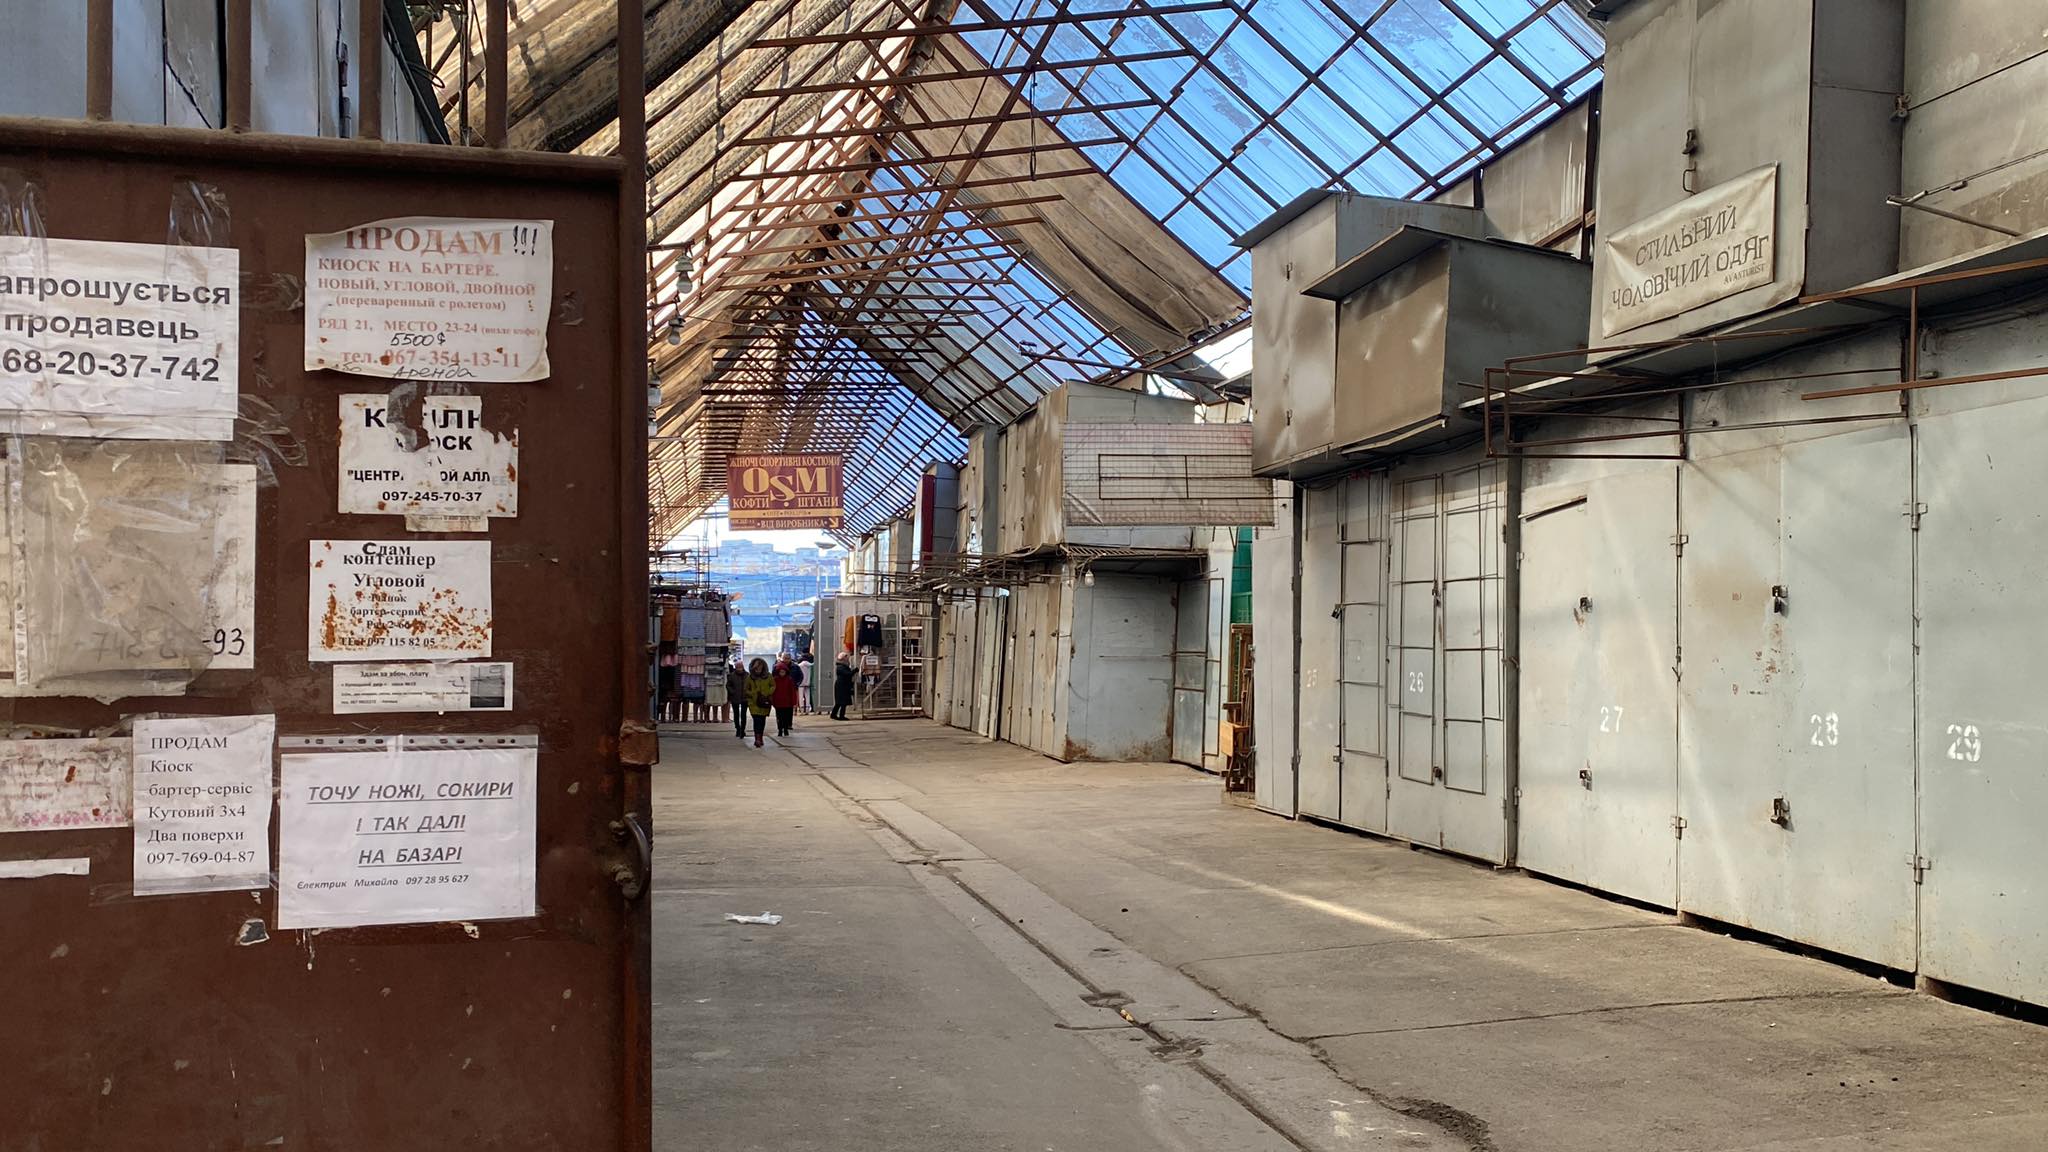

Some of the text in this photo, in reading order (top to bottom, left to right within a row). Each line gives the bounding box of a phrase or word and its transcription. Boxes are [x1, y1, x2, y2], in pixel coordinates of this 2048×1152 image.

[344, 227, 503, 256] ПРОДАМ
[1635, 203, 1737, 266] СТИЛЬНИЙ
[318, 258, 380, 272] КИОСК
[389, 261, 412, 273] НА
[0, 274, 231, 306] апрошується
[463, 283, 536, 297] ДВОЙНОЙ
[1612, 253, 1710, 310] ЧОЛОВІЧИЙ
[335, 295, 506, 312] (переваренный с ролетом)
[5, 314, 200, 343] продавець
[318, 318, 348, 330] РЯД
[384, 320, 438, 332] МЕСТО
[445, 322, 478, 333] 23-24
[2, 348, 220, 382] 68-20-37-742
[340, 351, 378, 364] тел.
[729, 455, 841, 467] ЖІНОЧІ СПОРТИВНІ КОСТЮМИ
[742, 467, 830, 502] OSM
[382, 491, 482, 501] 097-245-70-37
[733, 496, 839, 509] КОФТИ ШТАНИ
[761, 519, 776, 528] ВІД
[776, 518, 825, 528] ВИРОБНИКА
[362, 542, 411, 556] Сдам
[353, 573, 425, 587] Угловой
[389, 637, 406, 647] 115
[408, 637, 420, 647] 82
[423, 637, 436, 647] 05
[1409, 671, 1424, 693] 26
[1600, 706, 1623, 733] 27
[1810, 712, 1839, 747] 28
[151, 736, 228, 750] ПРОДАМ
[1946, 724, 1981, 762] 29
[150, 759, 193, 772] Кіоск
[149, 782, 253, 799] бартер-сервіс
[308, 781, 514, 801] ТОЧУ НОЖІ, СОКИРИ
[149, 805, 215, 822] Кутовий
[356, 814, 466, 833] І ТАК ДАЛІ
[147, 829, 244, 845] Два поверхи
[147, 850, 255, 865] 097-769-04-87
[358, 846, 462, 864] НА БАЗАРІ
[297, 874, 469, 890] Єлектрик Михайло 097 28 95 627
